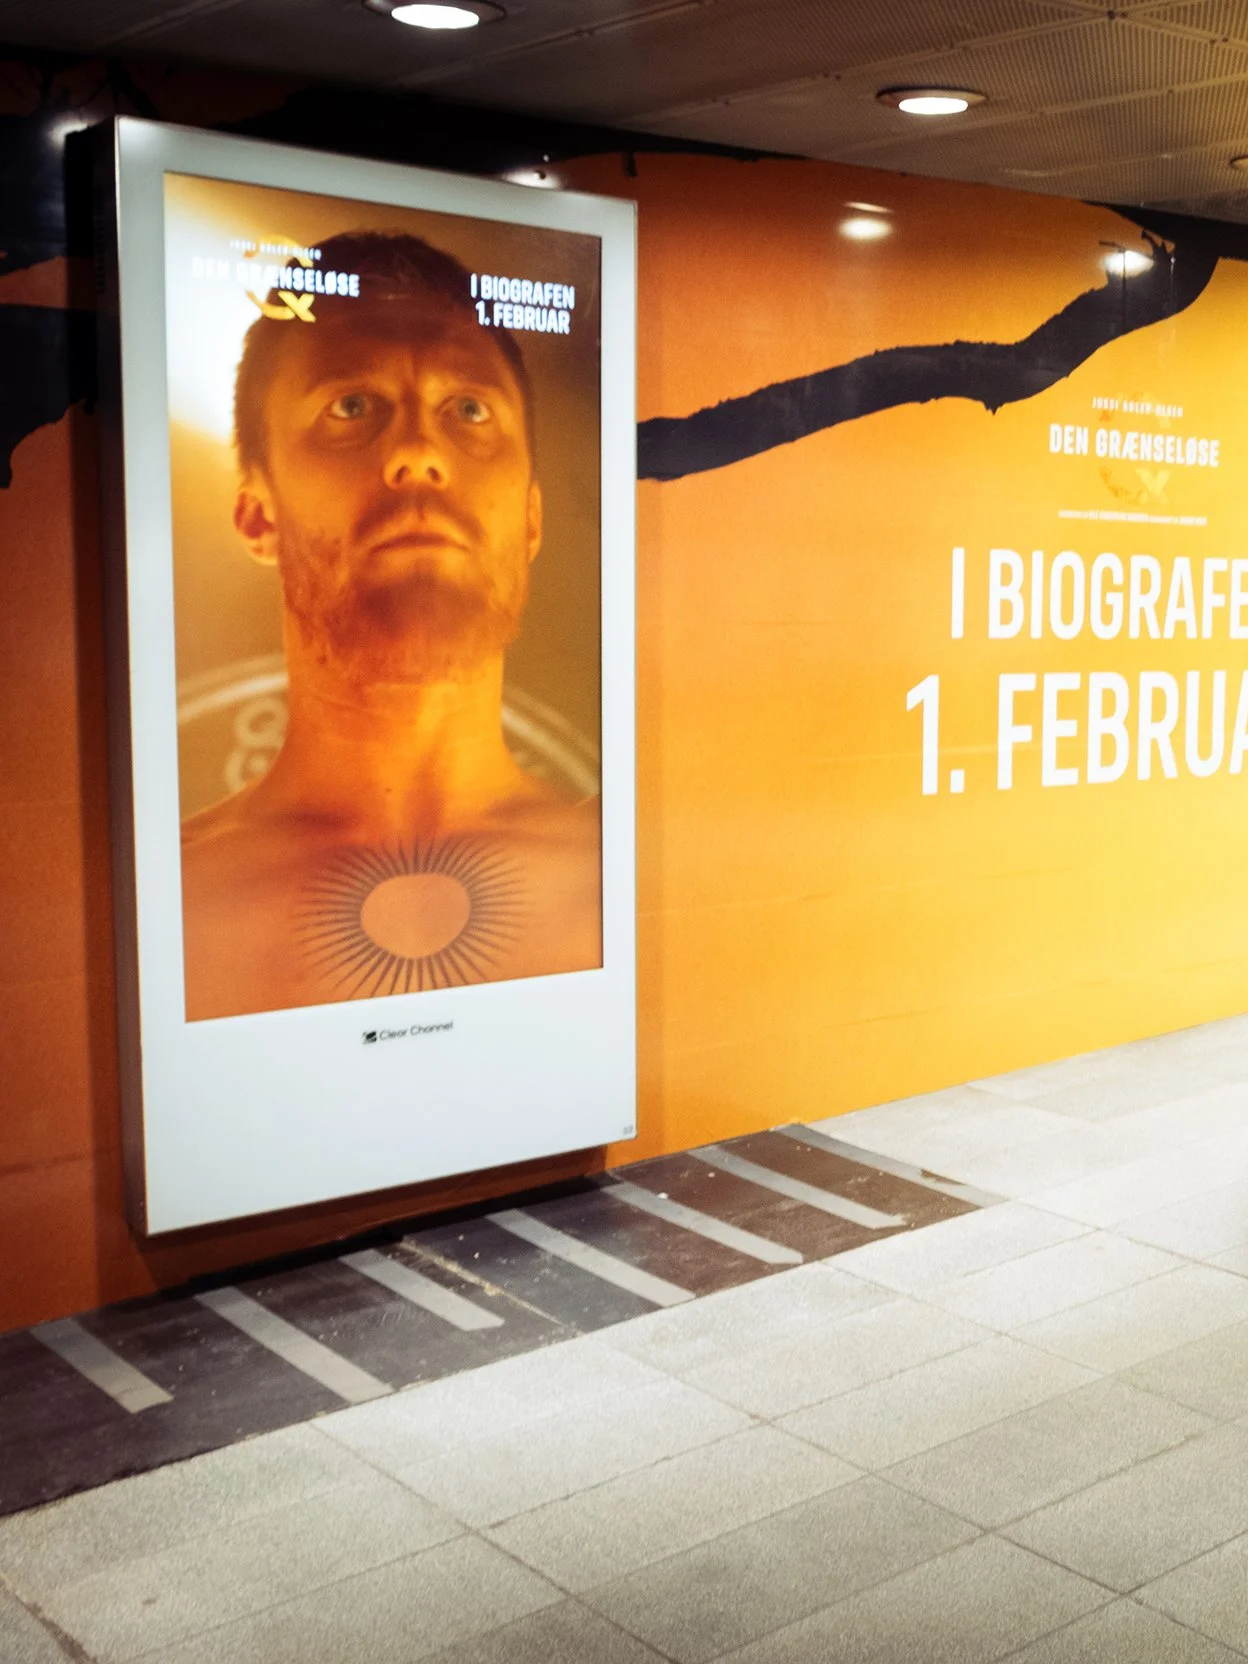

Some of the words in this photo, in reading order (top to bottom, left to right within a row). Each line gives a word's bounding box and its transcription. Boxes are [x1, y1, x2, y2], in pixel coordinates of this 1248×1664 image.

[470, 273, 477, 298] I
[481, 274, 575, 310] BIOGRAFEN
[475, 300, 491, 326] 1.
[493, 302, 570, 335] FEBRUAR
[1049, 423, 1089, 456] DEN
[1095, 428, 1220, 468] GRÆNSELØSE
[951, 547, 965, 639] I
[906, 675, 965, 795] 1.
[379, 1028, 407, 1041] Clear
[410, 1020, 454, 1036] Channel
